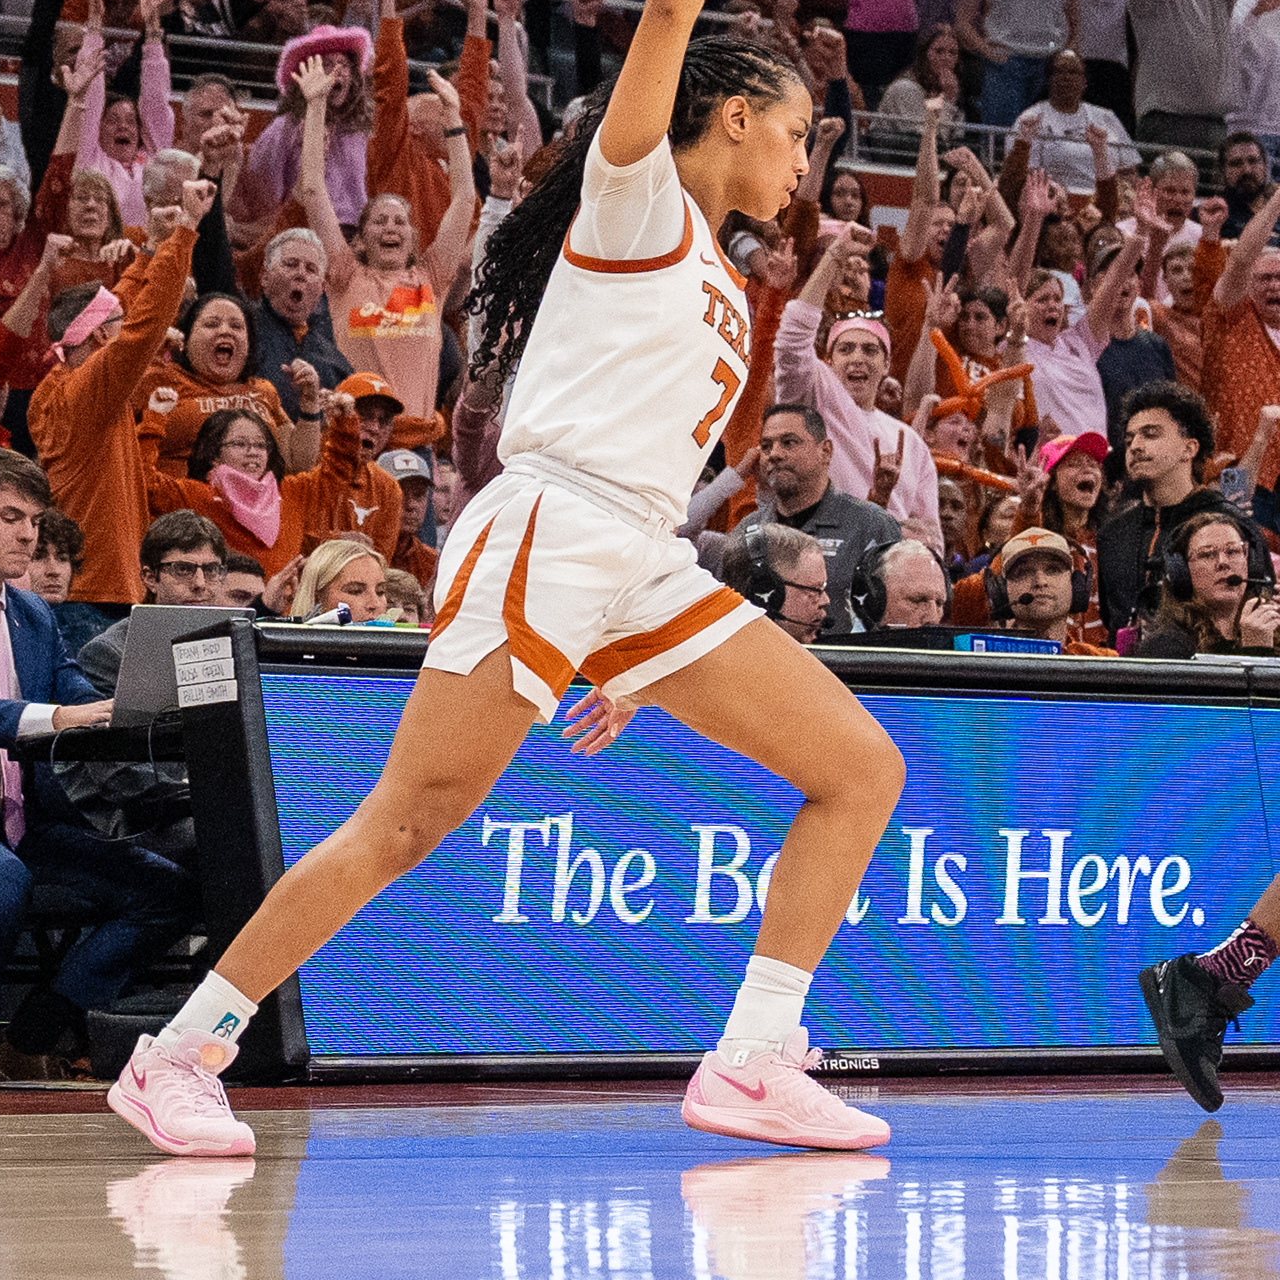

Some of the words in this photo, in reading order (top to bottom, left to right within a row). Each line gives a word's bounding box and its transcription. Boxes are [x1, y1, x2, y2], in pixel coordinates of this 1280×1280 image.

[691, 356, 741, 449] 7
[481, 812, 657, 926] The
[897, 826, 968, 927] Is
[994, 828, 1206, 928] Here.
